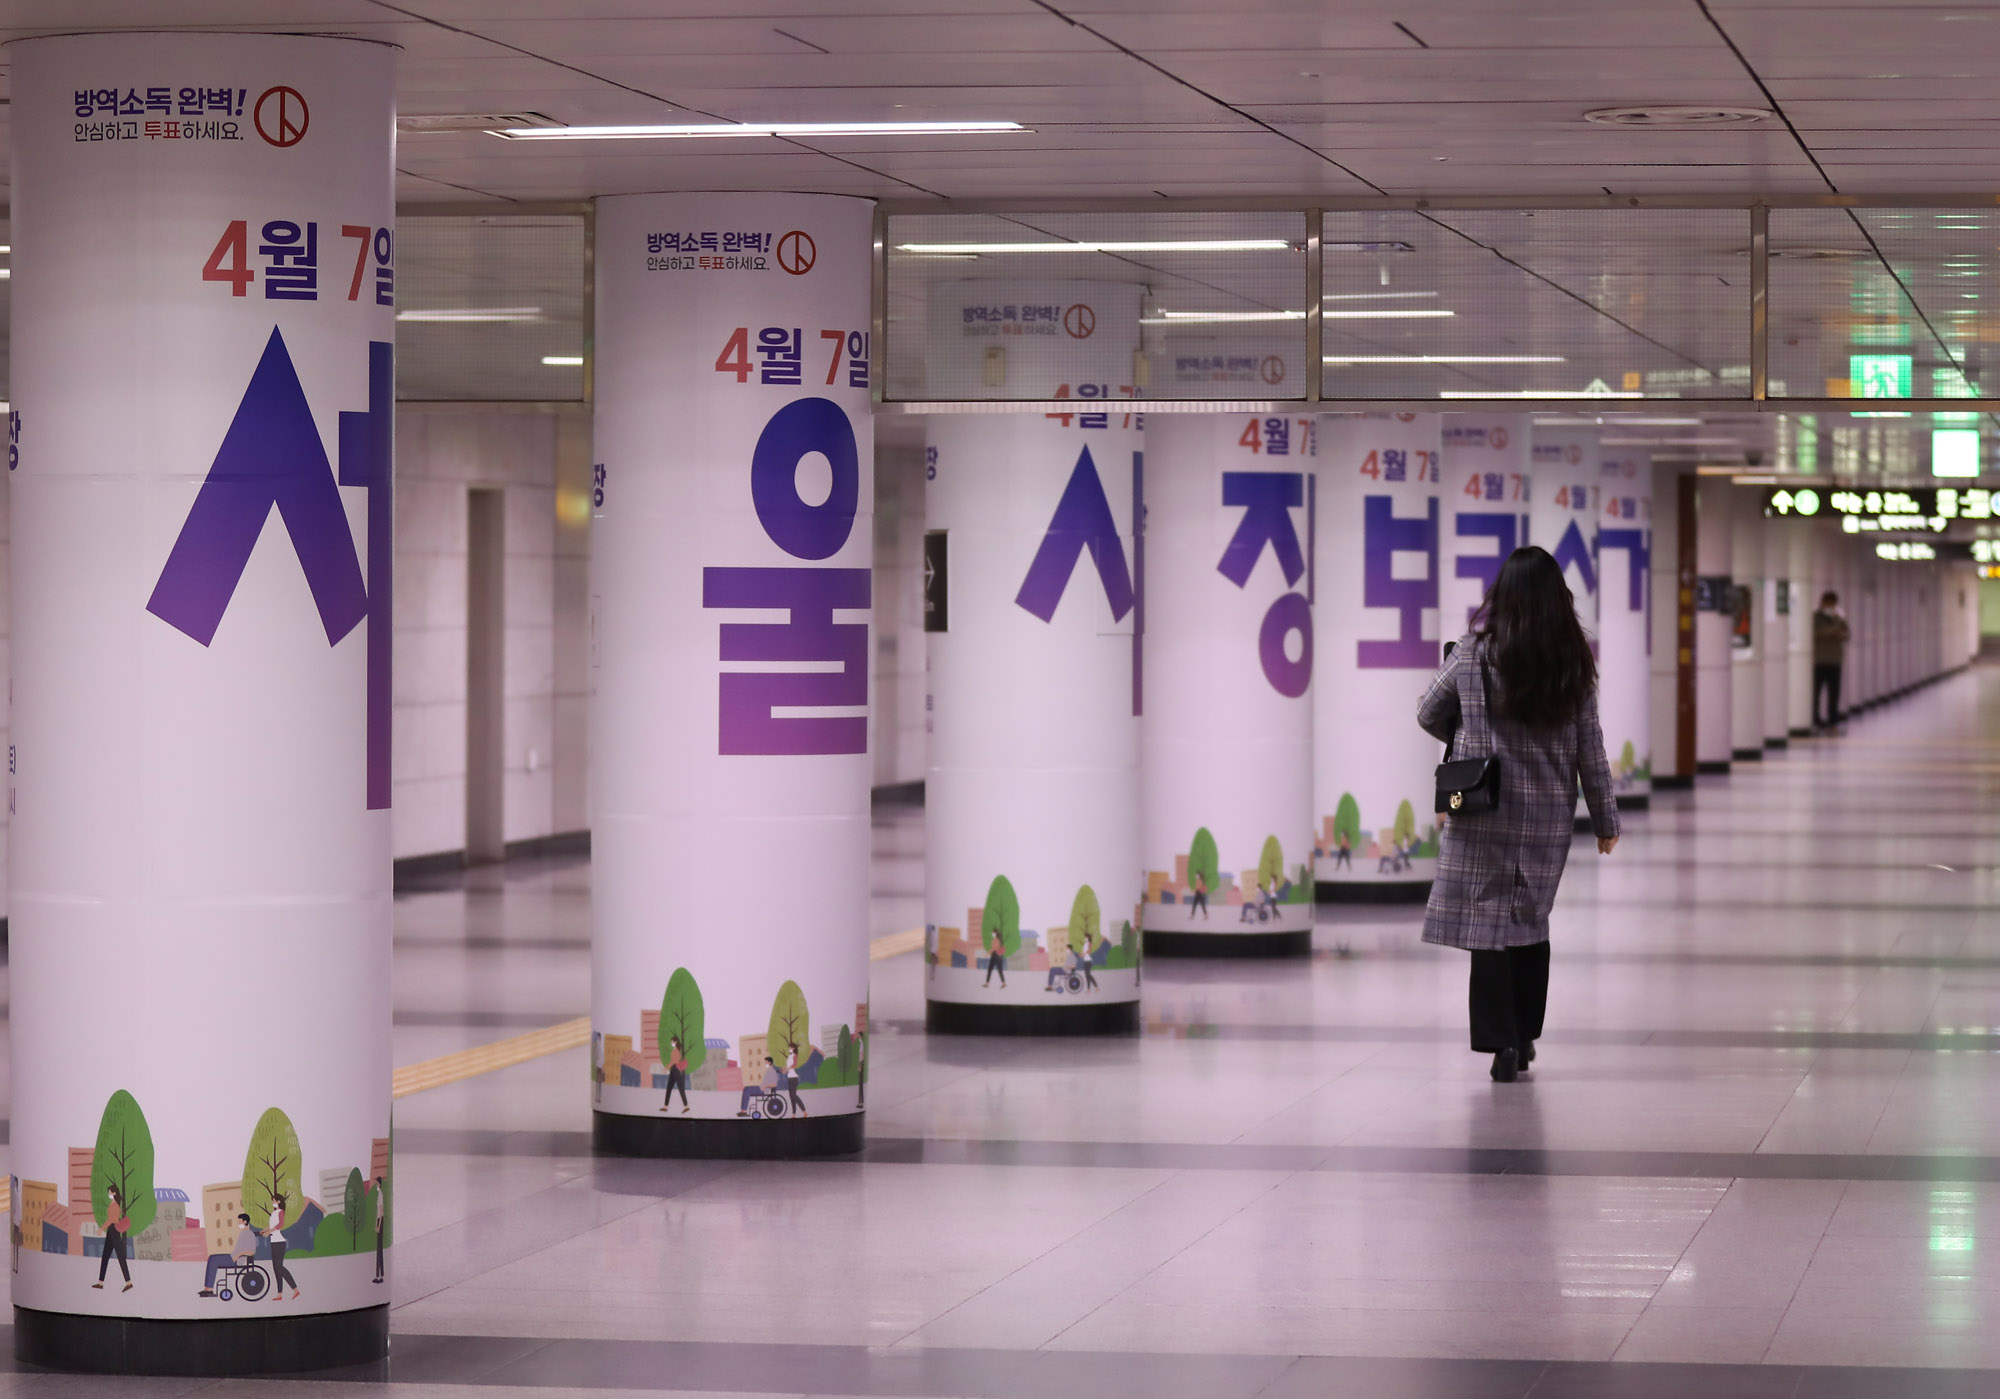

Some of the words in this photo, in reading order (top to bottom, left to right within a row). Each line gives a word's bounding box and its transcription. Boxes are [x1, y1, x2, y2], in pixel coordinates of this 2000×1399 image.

[74, 87, 172, 117] 방역소독
[178, 87, 247, 116] 완벽!
[74, 121, 138, 142] 안심하고
[143, 121, 244, 141] 투표하세요.
[647, 232, 718, 253] 방역소독
[722, 232, 772, 253] 완벽!
[202, 220, 317, 301] 4월
[341, 225, 394, 306] 7일
[647, 256, 695, 271] 안심하고
[698, 256, 770, 271] 투표하세요.
[715, 327, 802, 385] 4월
[821, 330, 869, 388] 7일
[1238, 417, 1290, 455] 4월
[1359, 449, 1406, 482] 4월
[703, 397, 871, 755] 울
[1357, 495, 1440, 669] 보
